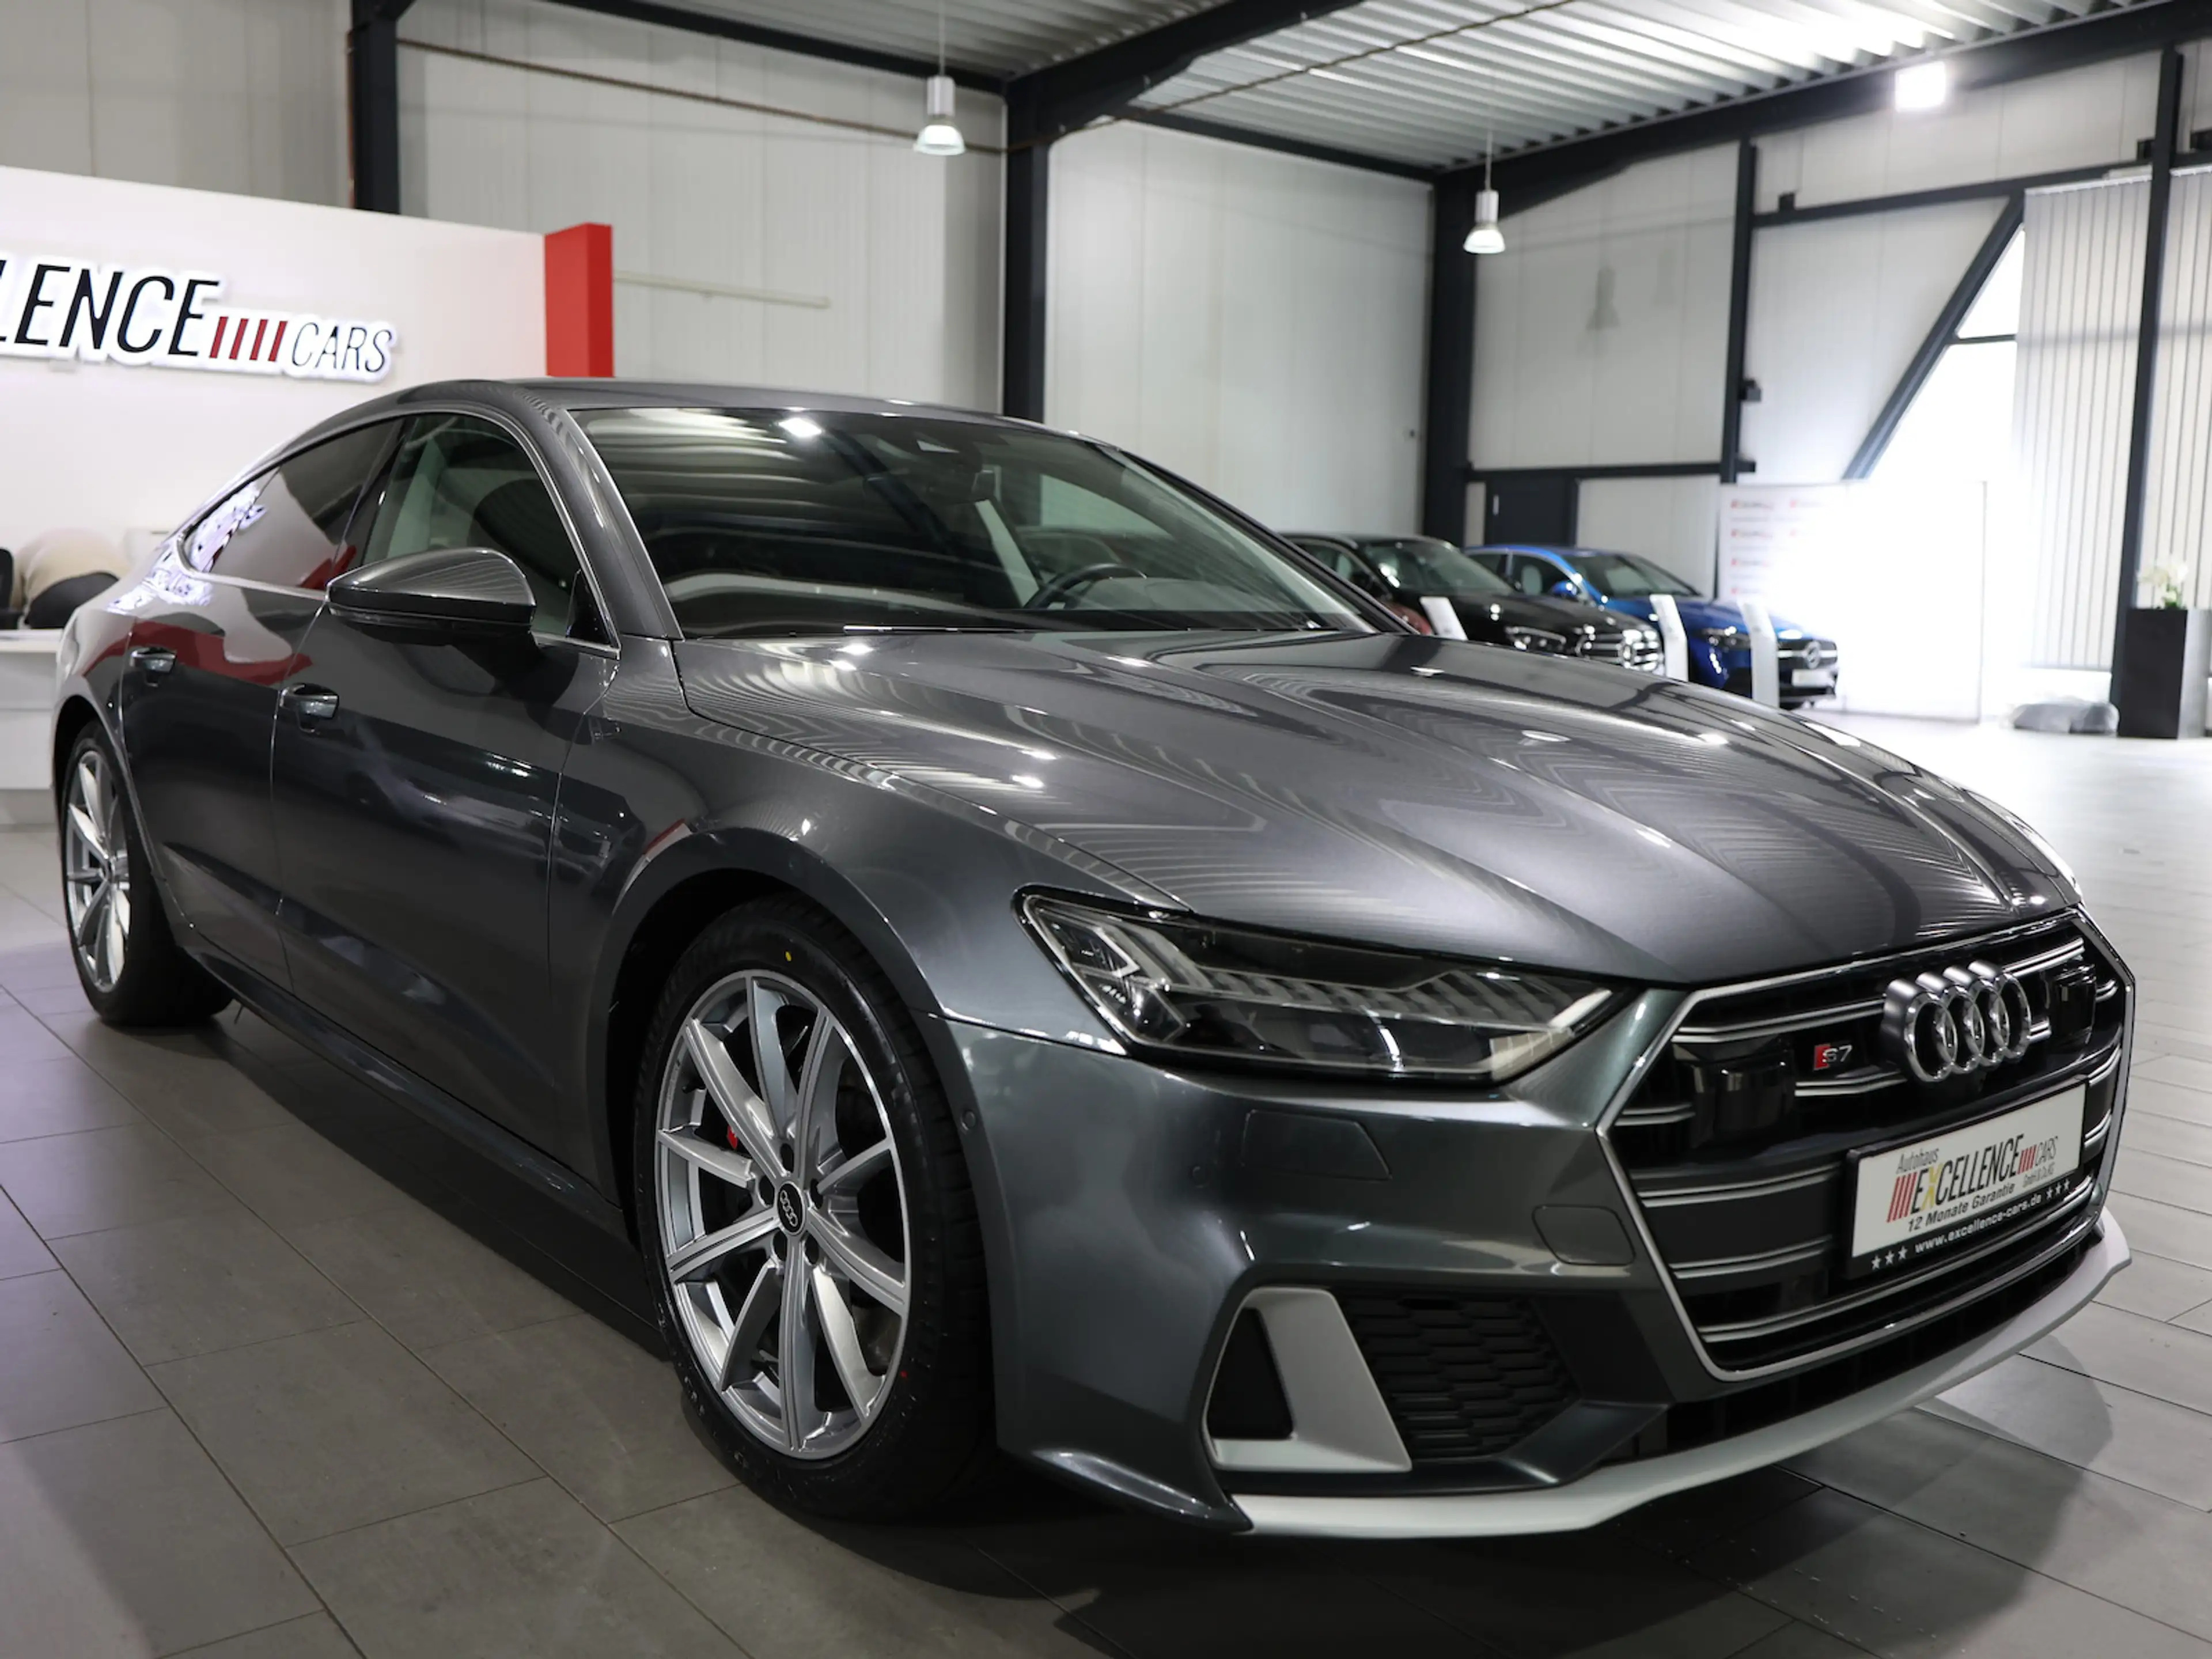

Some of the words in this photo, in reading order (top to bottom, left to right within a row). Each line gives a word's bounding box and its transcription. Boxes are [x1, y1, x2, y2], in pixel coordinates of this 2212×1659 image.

[291, 322, 392, 372] CARS
[1822, 1045, 1853, 1062] S7
[1895, 1147, 1940, 1174] Autohaus
[1910, 1133, 2024, 1214] EXCELLENCE
[2035, 1135, 2059, 1166] CARS
[1908, 1215, 1923, 1233] 12
[1925, 1202, 1969, 1227] Monate
[1971, 1183, 2016, 1209] Garantie
[1914, 1194, 2042, 1254] www.excellence-cars.de
